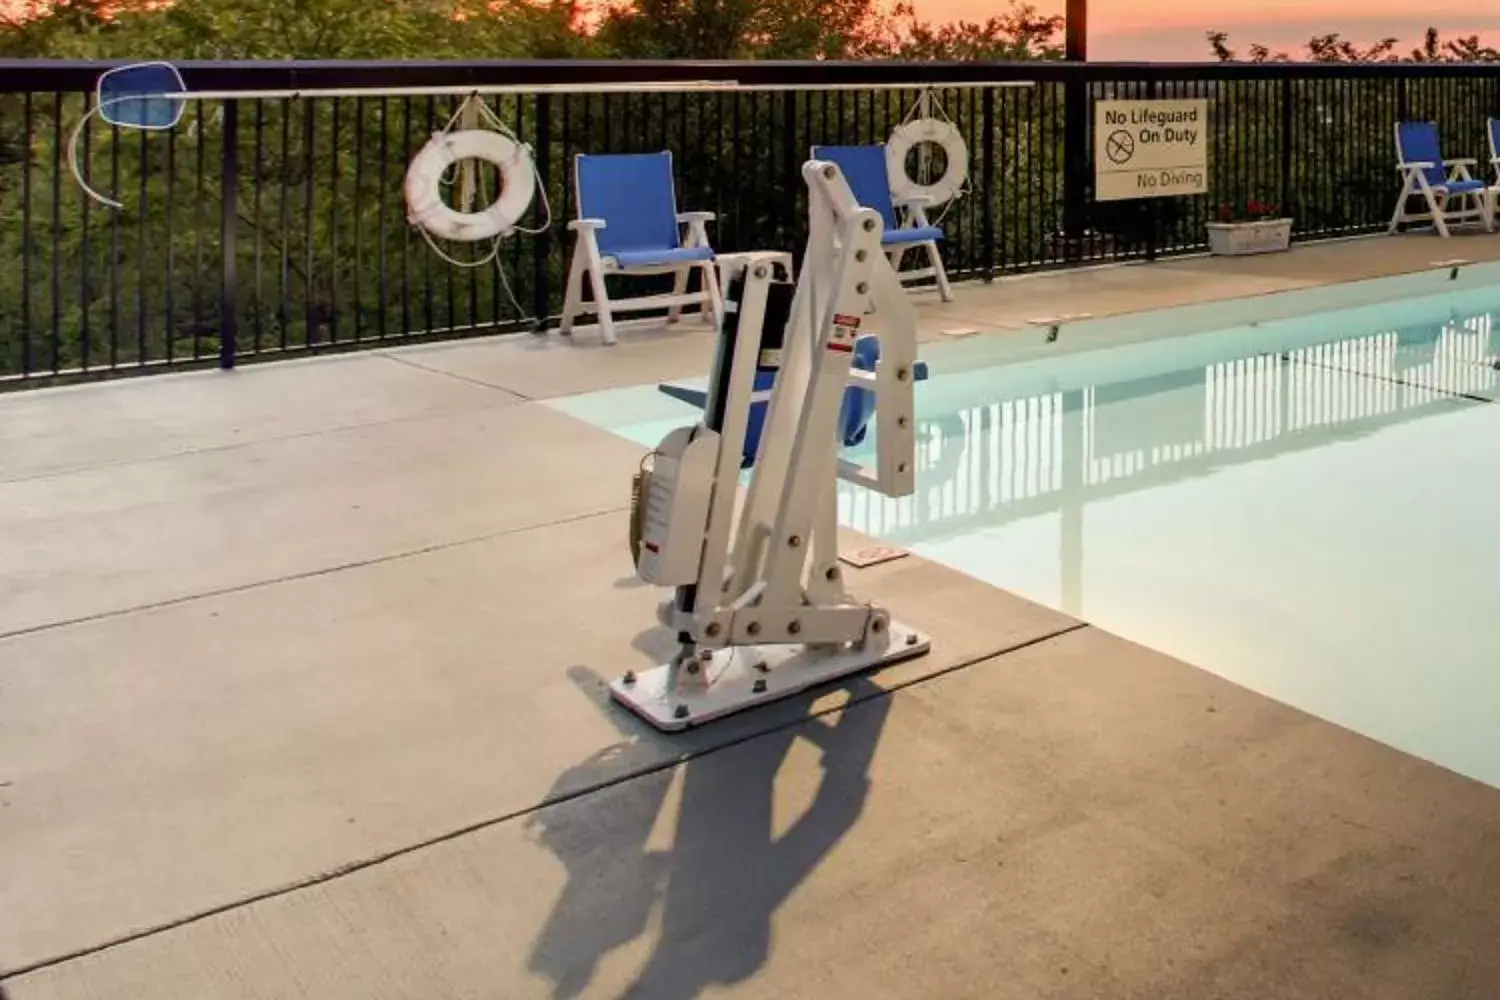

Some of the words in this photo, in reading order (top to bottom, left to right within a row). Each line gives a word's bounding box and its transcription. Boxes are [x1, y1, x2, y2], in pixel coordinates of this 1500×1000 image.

[1105, 110, 1127, 125] No
[1131, 108, 1197, 127] Lifeguard
[1139, 129, 1160, 143] On
[1165, 128, 1197, 145] Duty
[1137, 174, 1157, 188] No
[1161, 172, 1203, 188] Diving
